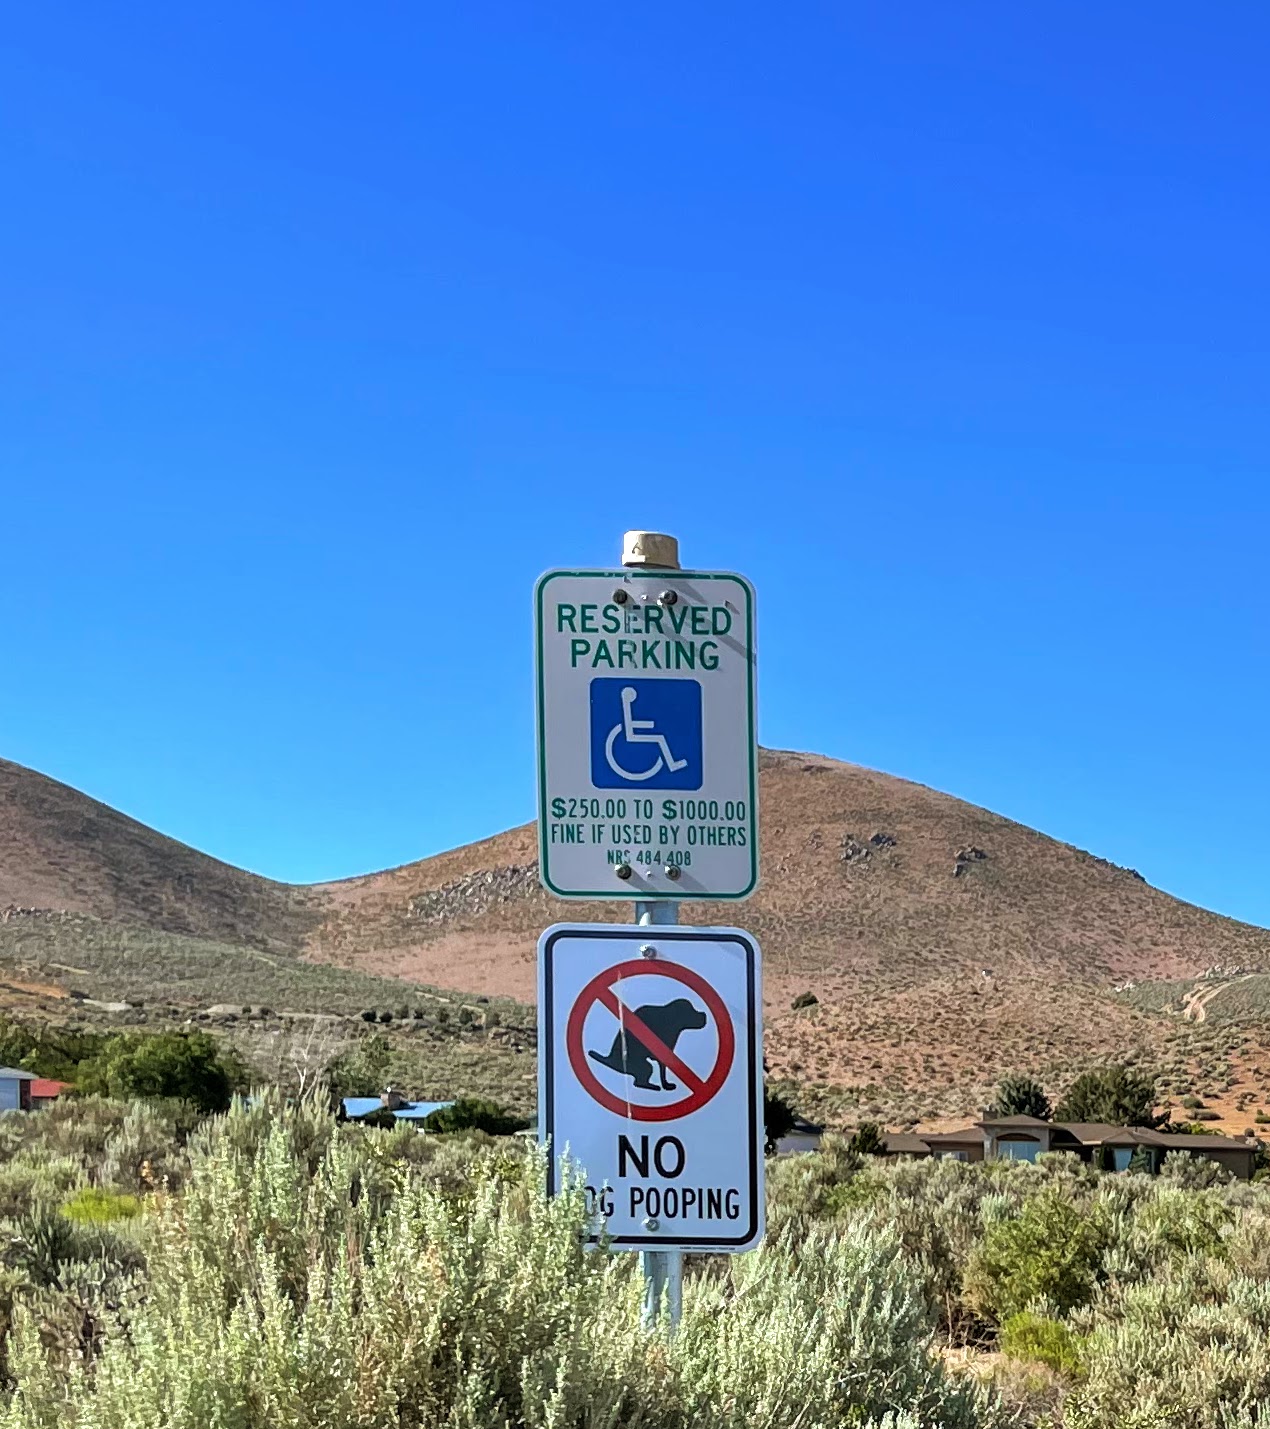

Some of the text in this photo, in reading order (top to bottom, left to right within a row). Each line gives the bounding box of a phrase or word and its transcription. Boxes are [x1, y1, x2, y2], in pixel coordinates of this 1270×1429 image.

[557, 603, 732, 635] RESERVED
[571, 638, 720, 671] PARKING
[551, 797, 746, 822] $250.00 TO $1000.00
[551, 823, 747, 847] FINE IF USED BY OTHERS
[606, 849, 631, 865] NRS
[617, 1134, 686, 1180] NO
[578, 1186, 741, 1220] OG POOPING
